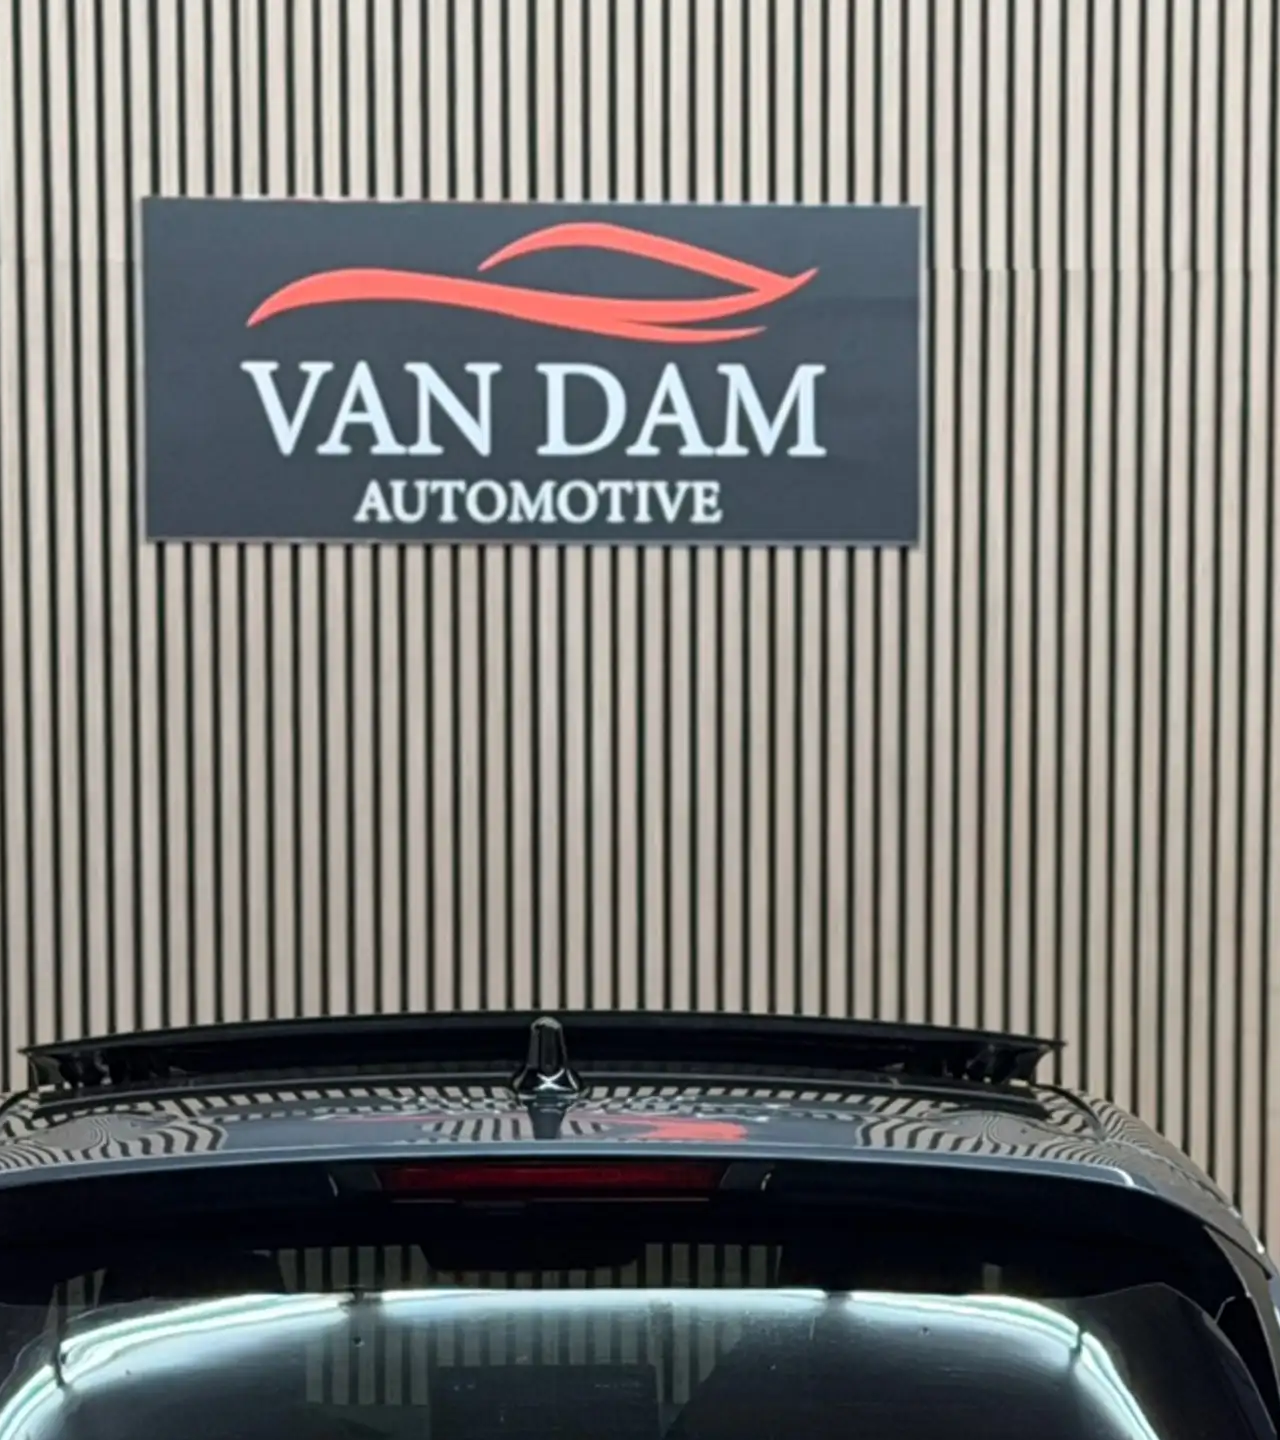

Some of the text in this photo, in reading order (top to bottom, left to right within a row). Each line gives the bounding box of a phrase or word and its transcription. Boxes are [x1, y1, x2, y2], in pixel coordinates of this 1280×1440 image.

[240, 360, 827, 457] VAN DAM
[354, 479, 722, 524] AUTOMOTIVE
